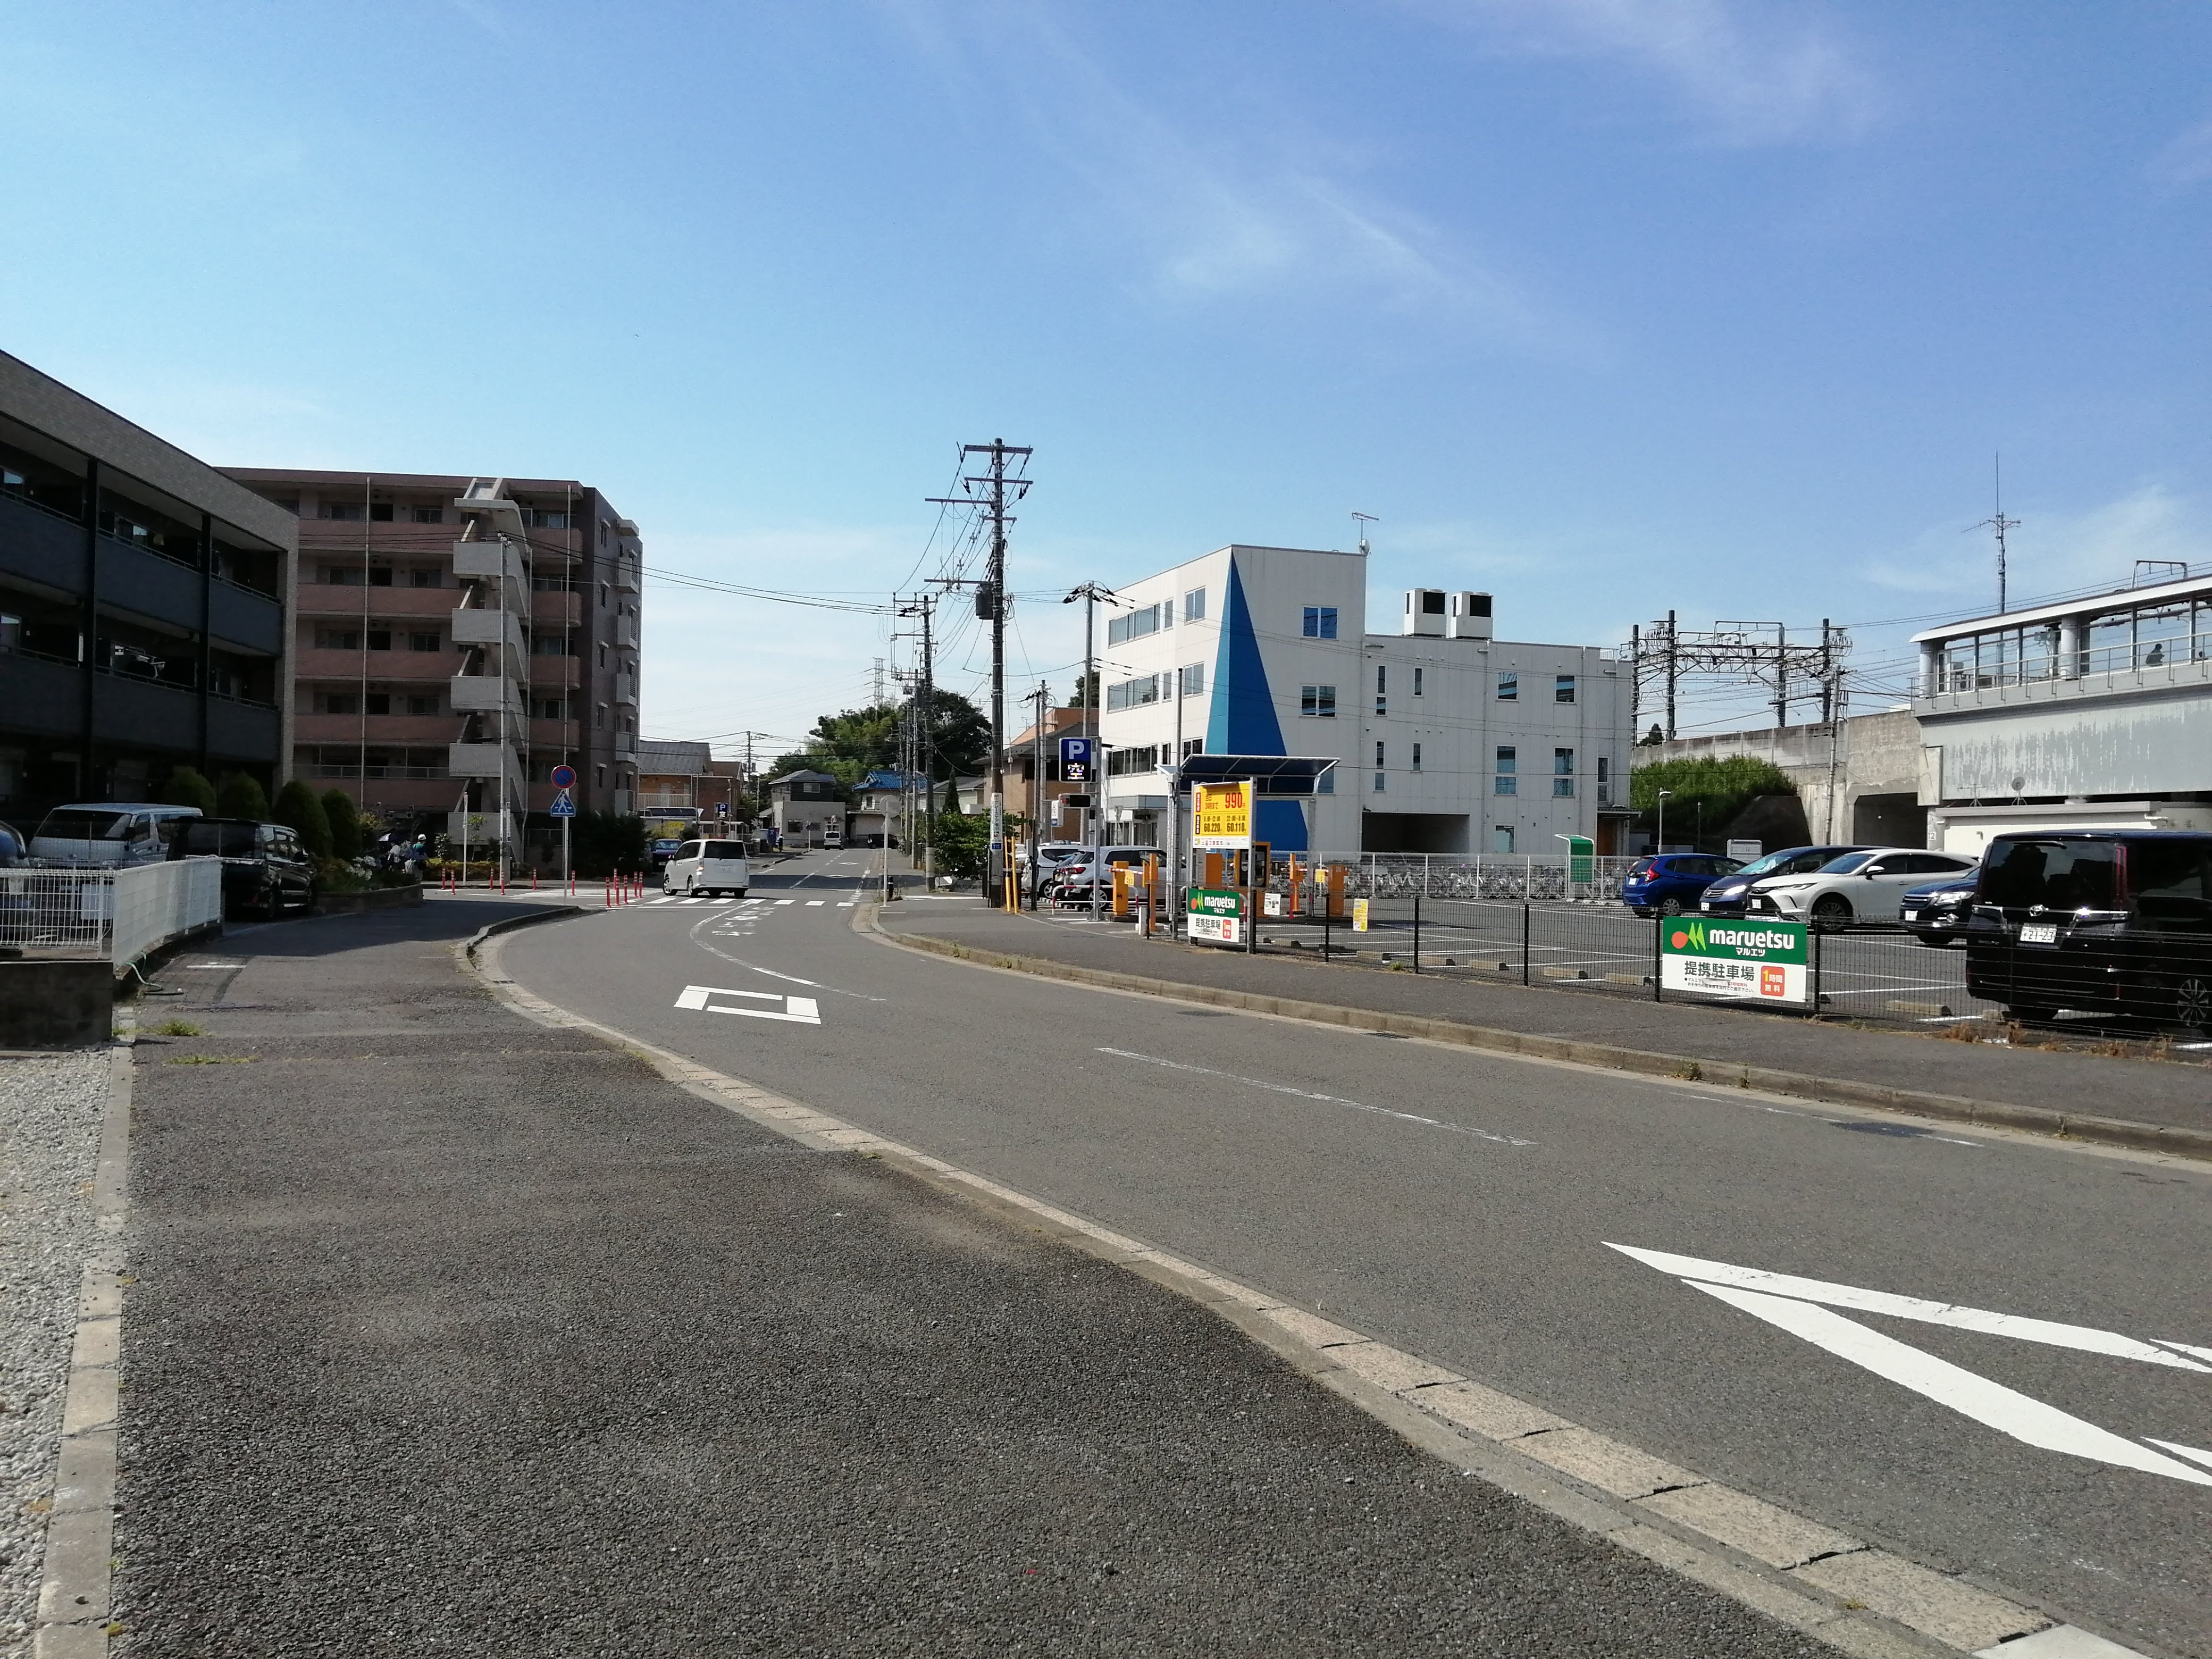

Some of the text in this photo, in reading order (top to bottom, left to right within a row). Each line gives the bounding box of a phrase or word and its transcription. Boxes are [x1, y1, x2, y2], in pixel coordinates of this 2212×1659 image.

[1069, 741, 1085, 759] P
[1204, 896, 1236, 909] maruetsu
[1709, 929, 1795, 950] maruetsu
[1735, 947, 1766, 957] マルエツ
[1684, 960, 1755, 982] 提携駐車場
[1763, 969, 1783, 983] 1時間
[1764, 984, 1781, 993] 無料
